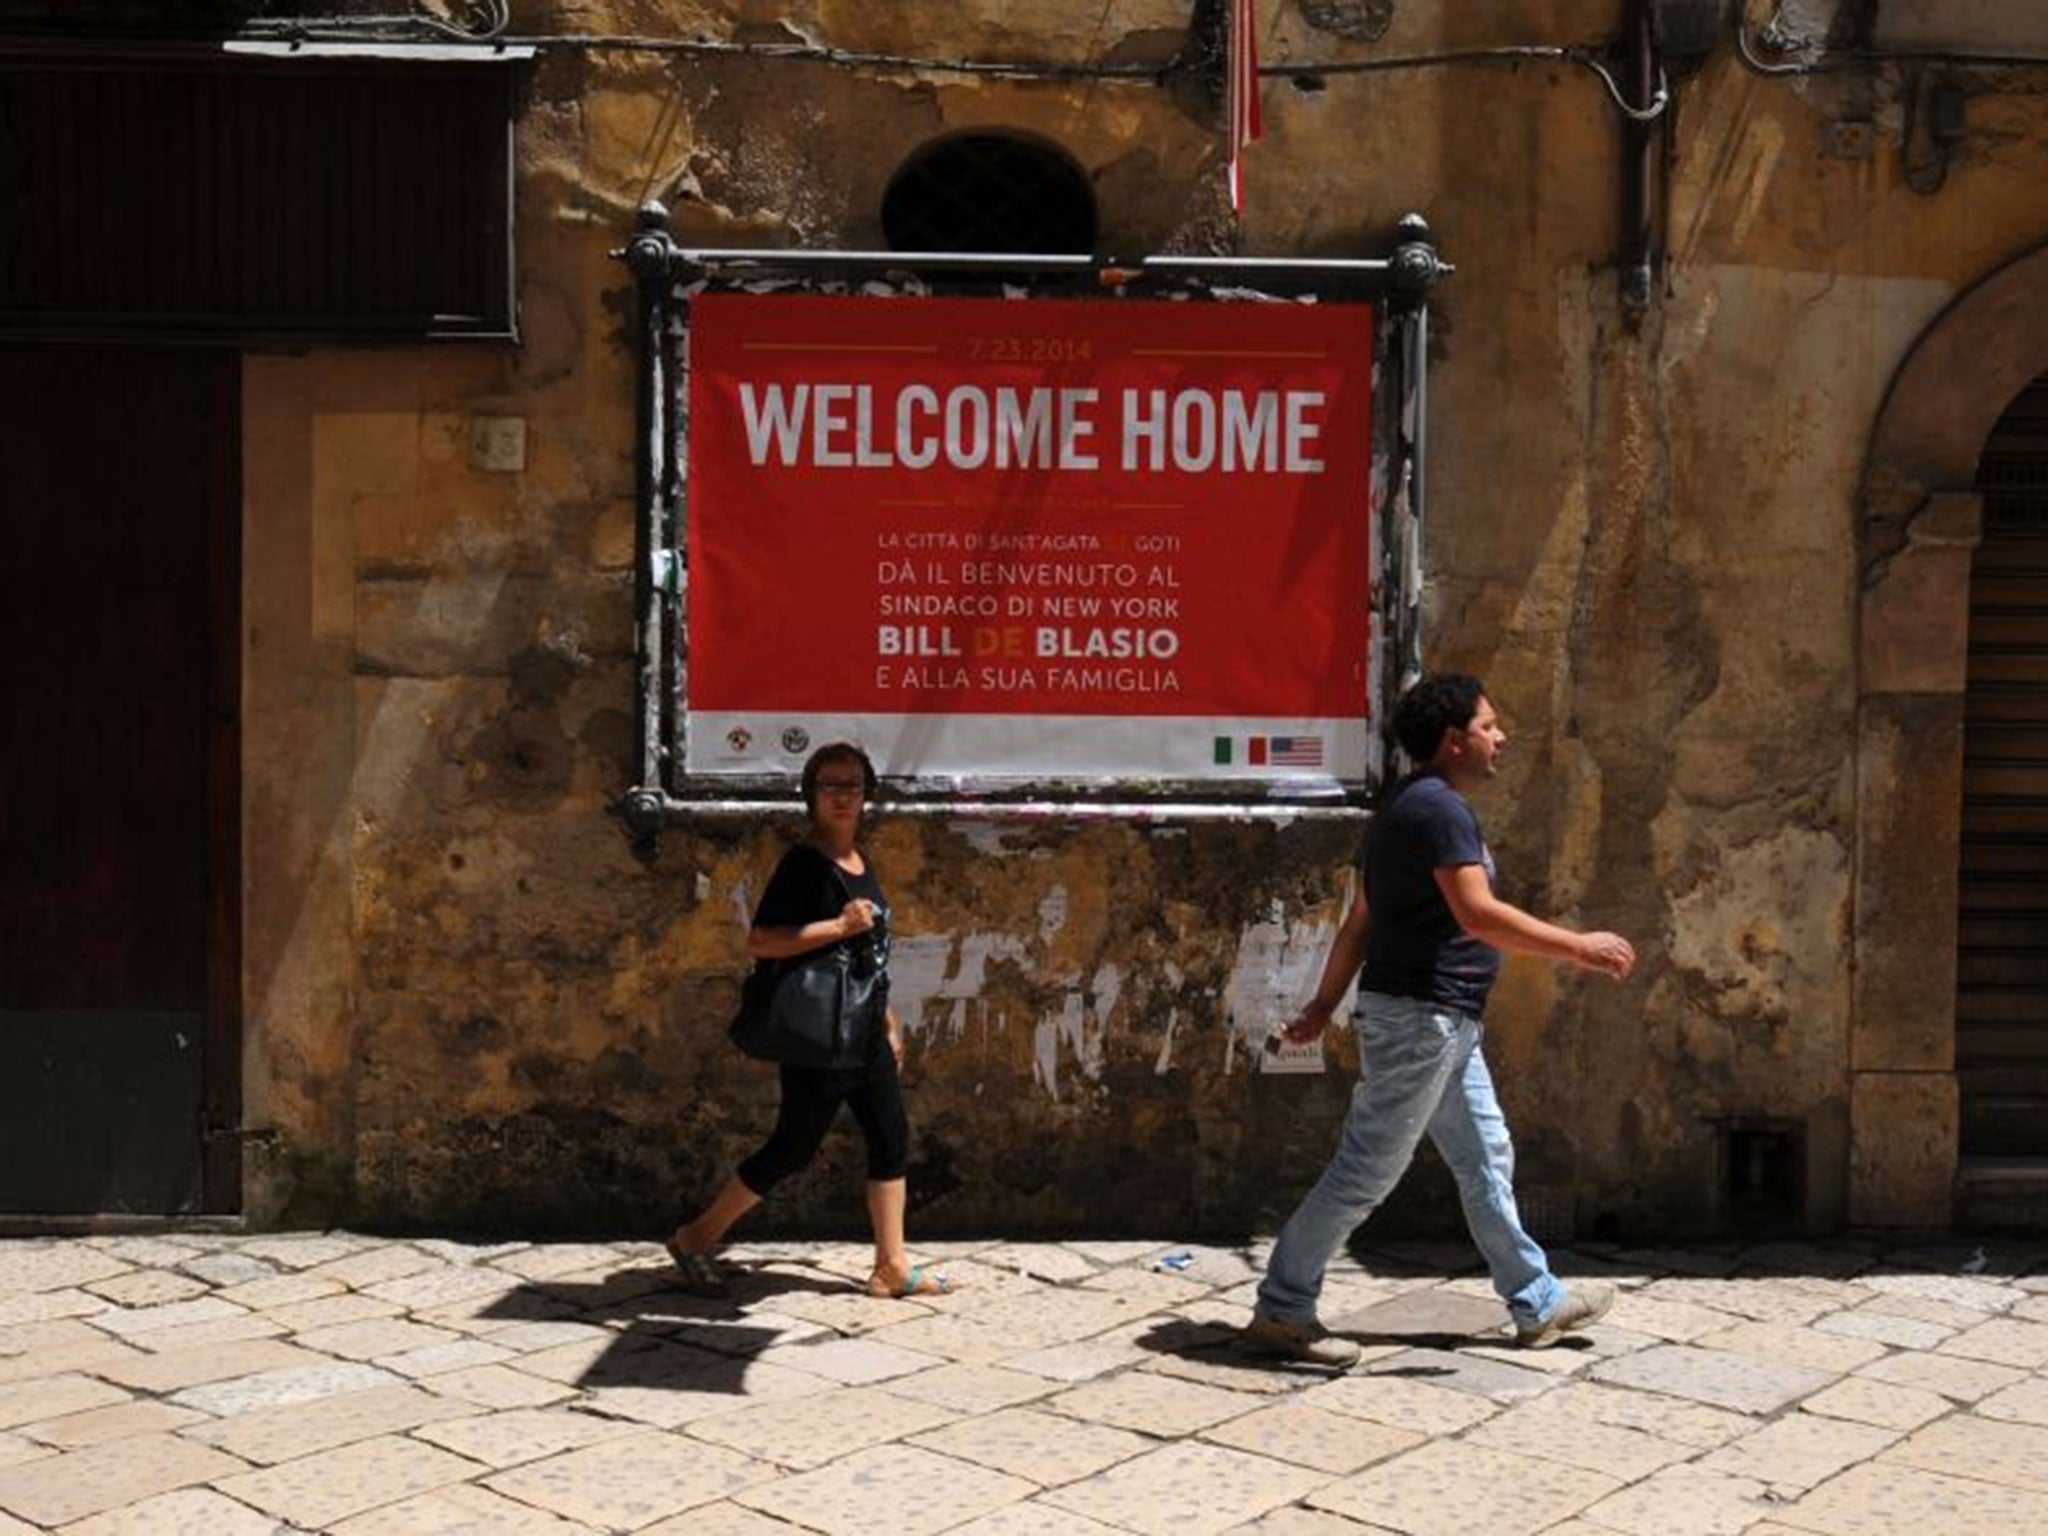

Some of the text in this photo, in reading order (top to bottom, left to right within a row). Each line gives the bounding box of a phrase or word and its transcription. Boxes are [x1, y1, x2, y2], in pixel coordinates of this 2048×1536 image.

[739, 383, 1326, 473] WELCOME HOME
[879, 533, 898, 548] LA
[1135, 536, 1180, 551] GOTI
[926, 563, 950, 584] IL
[961, 563, 1137, 587] BENVENUTO
[1147, 565, 1180, 587] AL
[879, 595, 1180, 618] SINDACO DI NEW YORK
[878, 625, 1180, 659] BILL DE BLASIO
[876, 667, 1180, 692] E ALLA SUA FAMIGLIA
